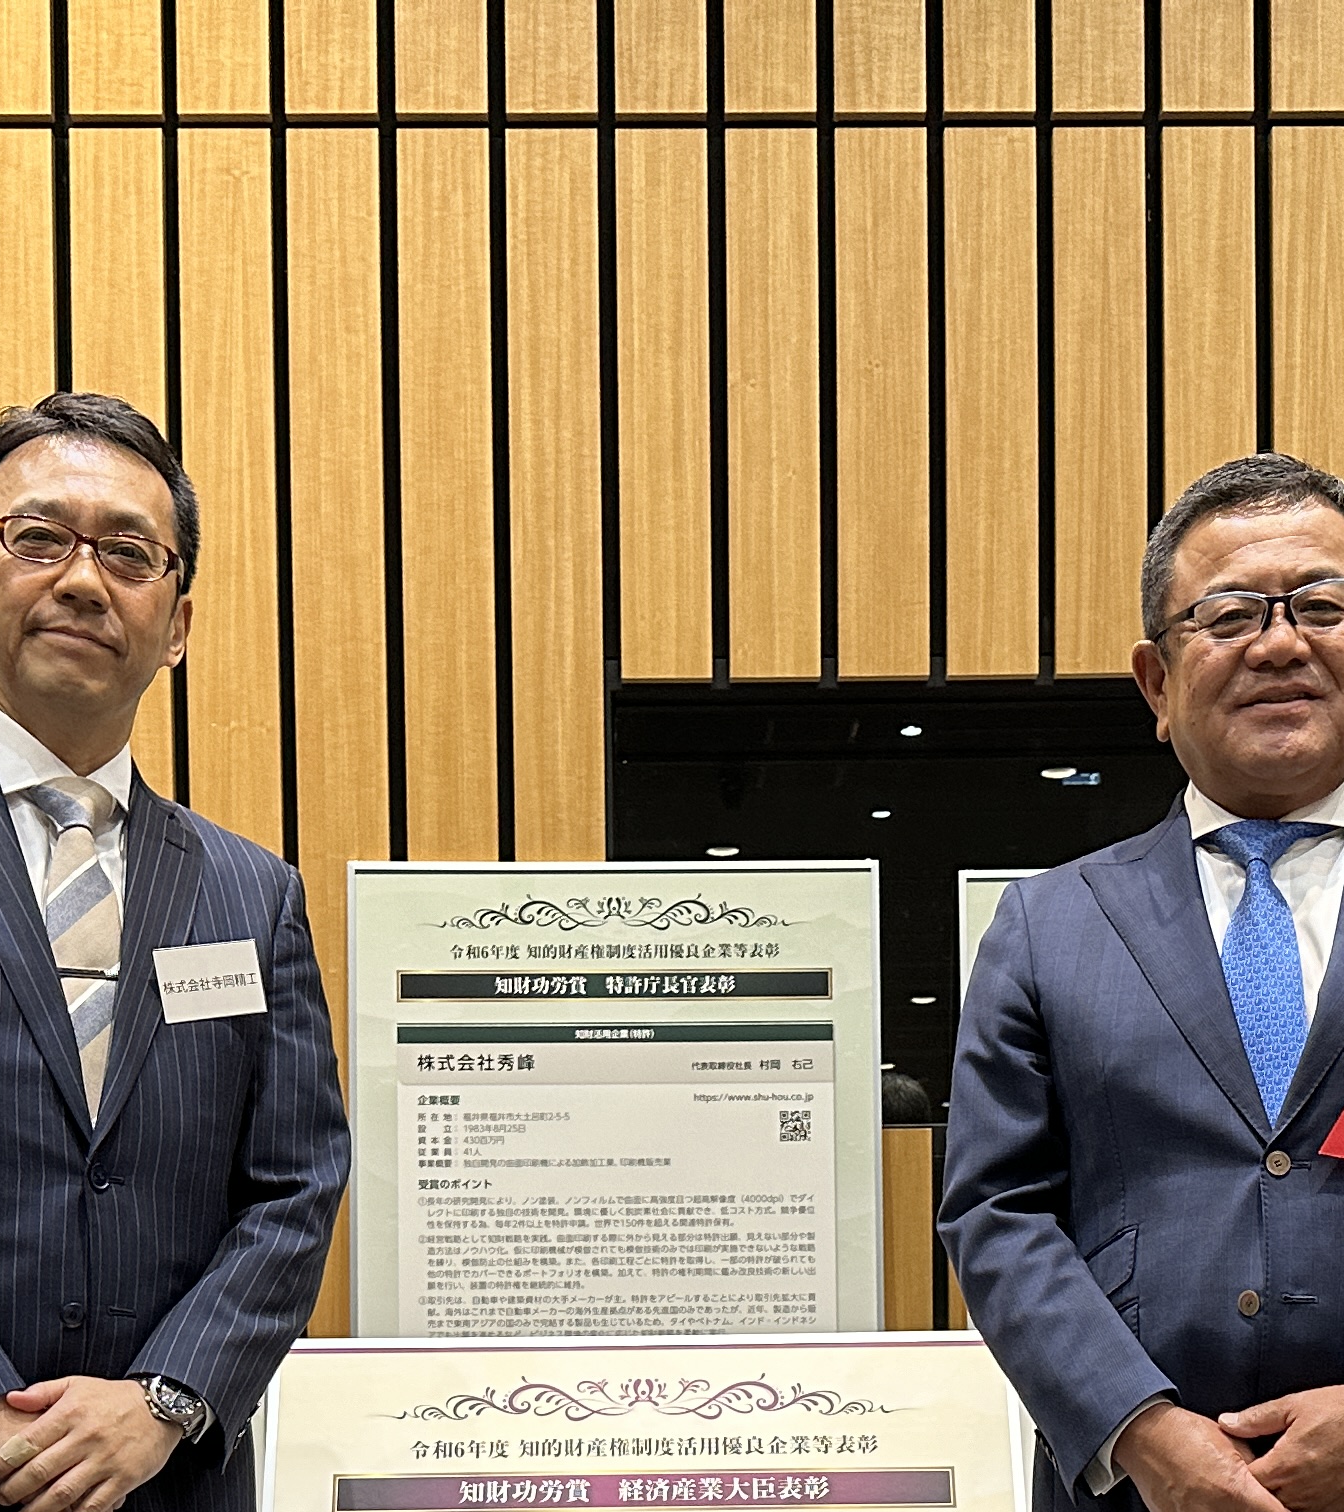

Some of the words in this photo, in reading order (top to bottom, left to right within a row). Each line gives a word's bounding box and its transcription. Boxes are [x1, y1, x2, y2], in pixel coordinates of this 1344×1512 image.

[450, 944, 520, 960] 令和6年度
[527, 943, 781, 960] 知的財産権制度活用優良企業等表彰
[163, 973, 258, 995] 株式会社寺岡精工
[495, 976, 587, 995] 知財功労賞
[606, 975, 735, 995] 特許庁長官表彰
[417, 1054, 535, 1071] 株式会社秀峰
[417, 1095, 460, 1105] 企業概要
[419, 1179, 492, 1190] 受賞のポイント
[410, 1439, 509, 1460] 令和6年度
[518, 1435, 879, 1458] 知的財産権制度活用優良企業等表彰
[460, 1478, 589, 1504] 知財功労賞
[619, 1476, 830, 1501] 経済産業大臣表彰
